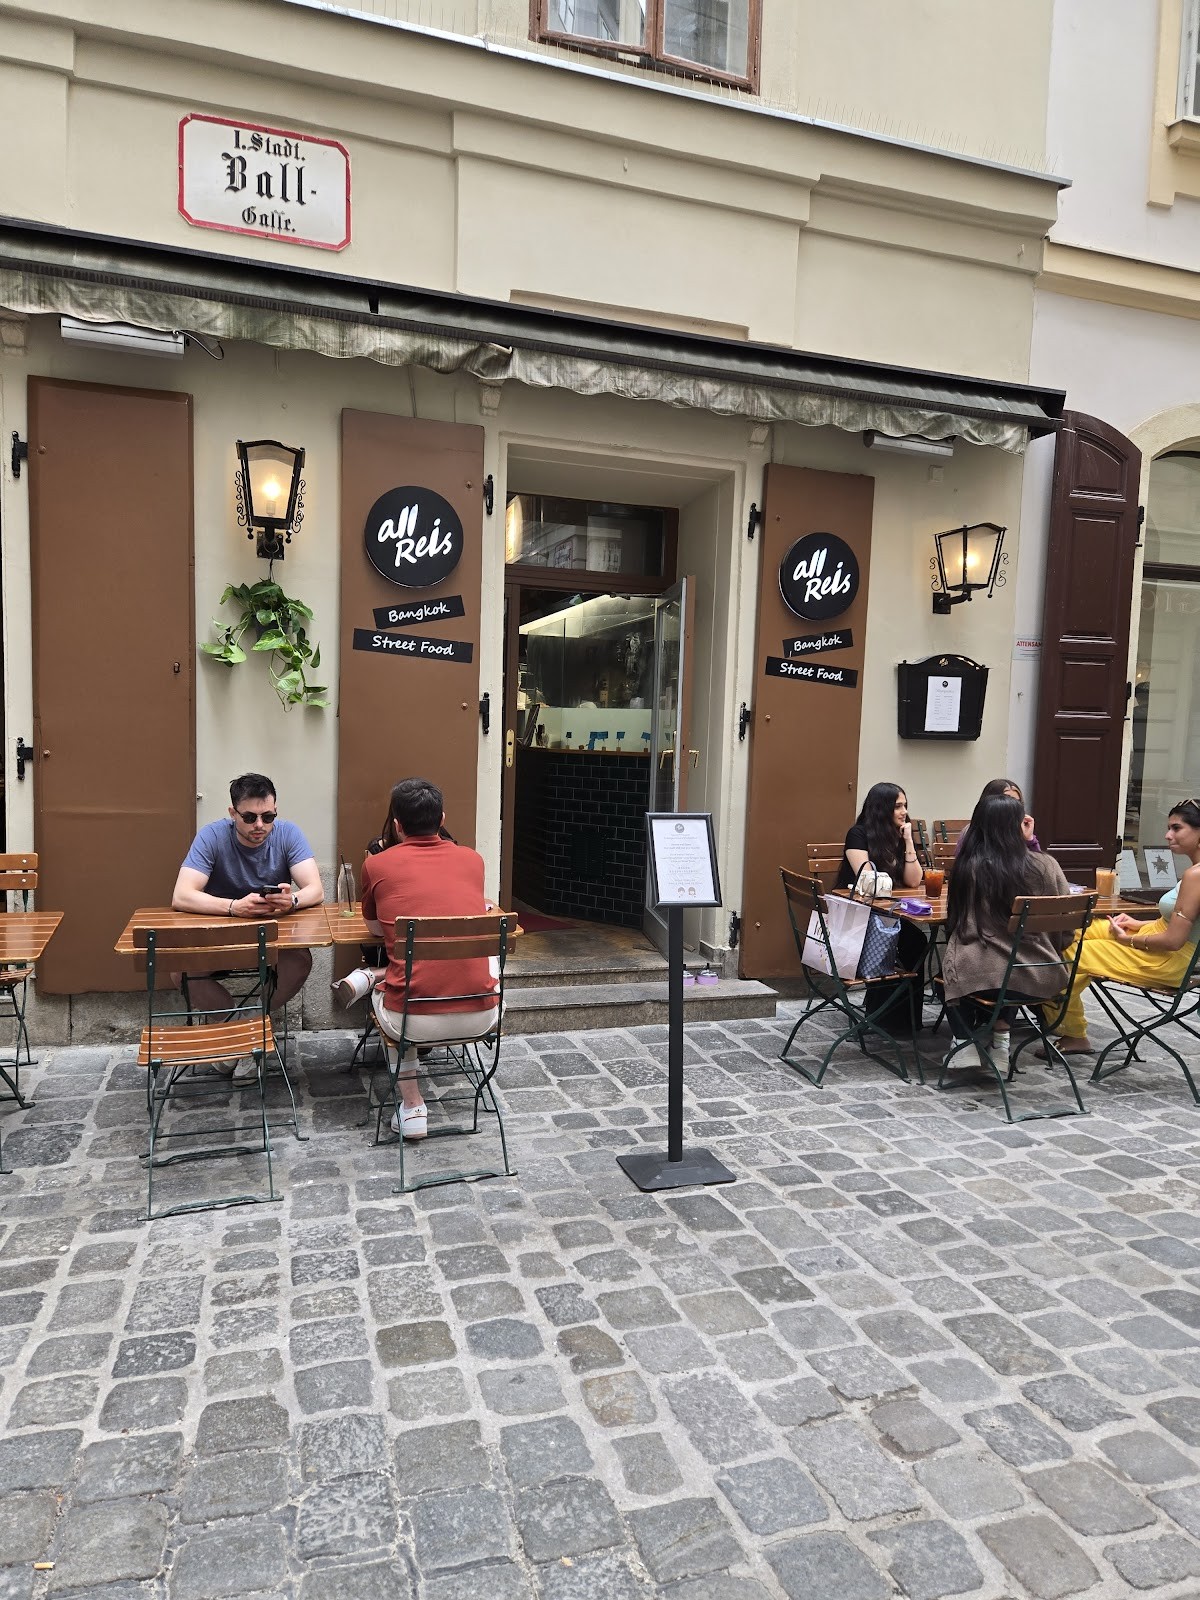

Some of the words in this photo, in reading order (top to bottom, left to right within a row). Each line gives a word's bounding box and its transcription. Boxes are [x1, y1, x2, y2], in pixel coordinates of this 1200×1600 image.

[221, 152, 317, 206] Ball-
[377, 503, 419, 543] all
[394, 518, 453, 568] Reis
[793, 547, 828, 581] all
[804, 561, 851, 603] Reis
[388, 601, 451, 623] Bangkok
[372, 634, 417, 652] Street
[420, 642, 455, 656] Food
[794, 634, 842, 652] Bangkok
[780, 662, 815, 677] Street
[816, 668, 844, 681] Food
